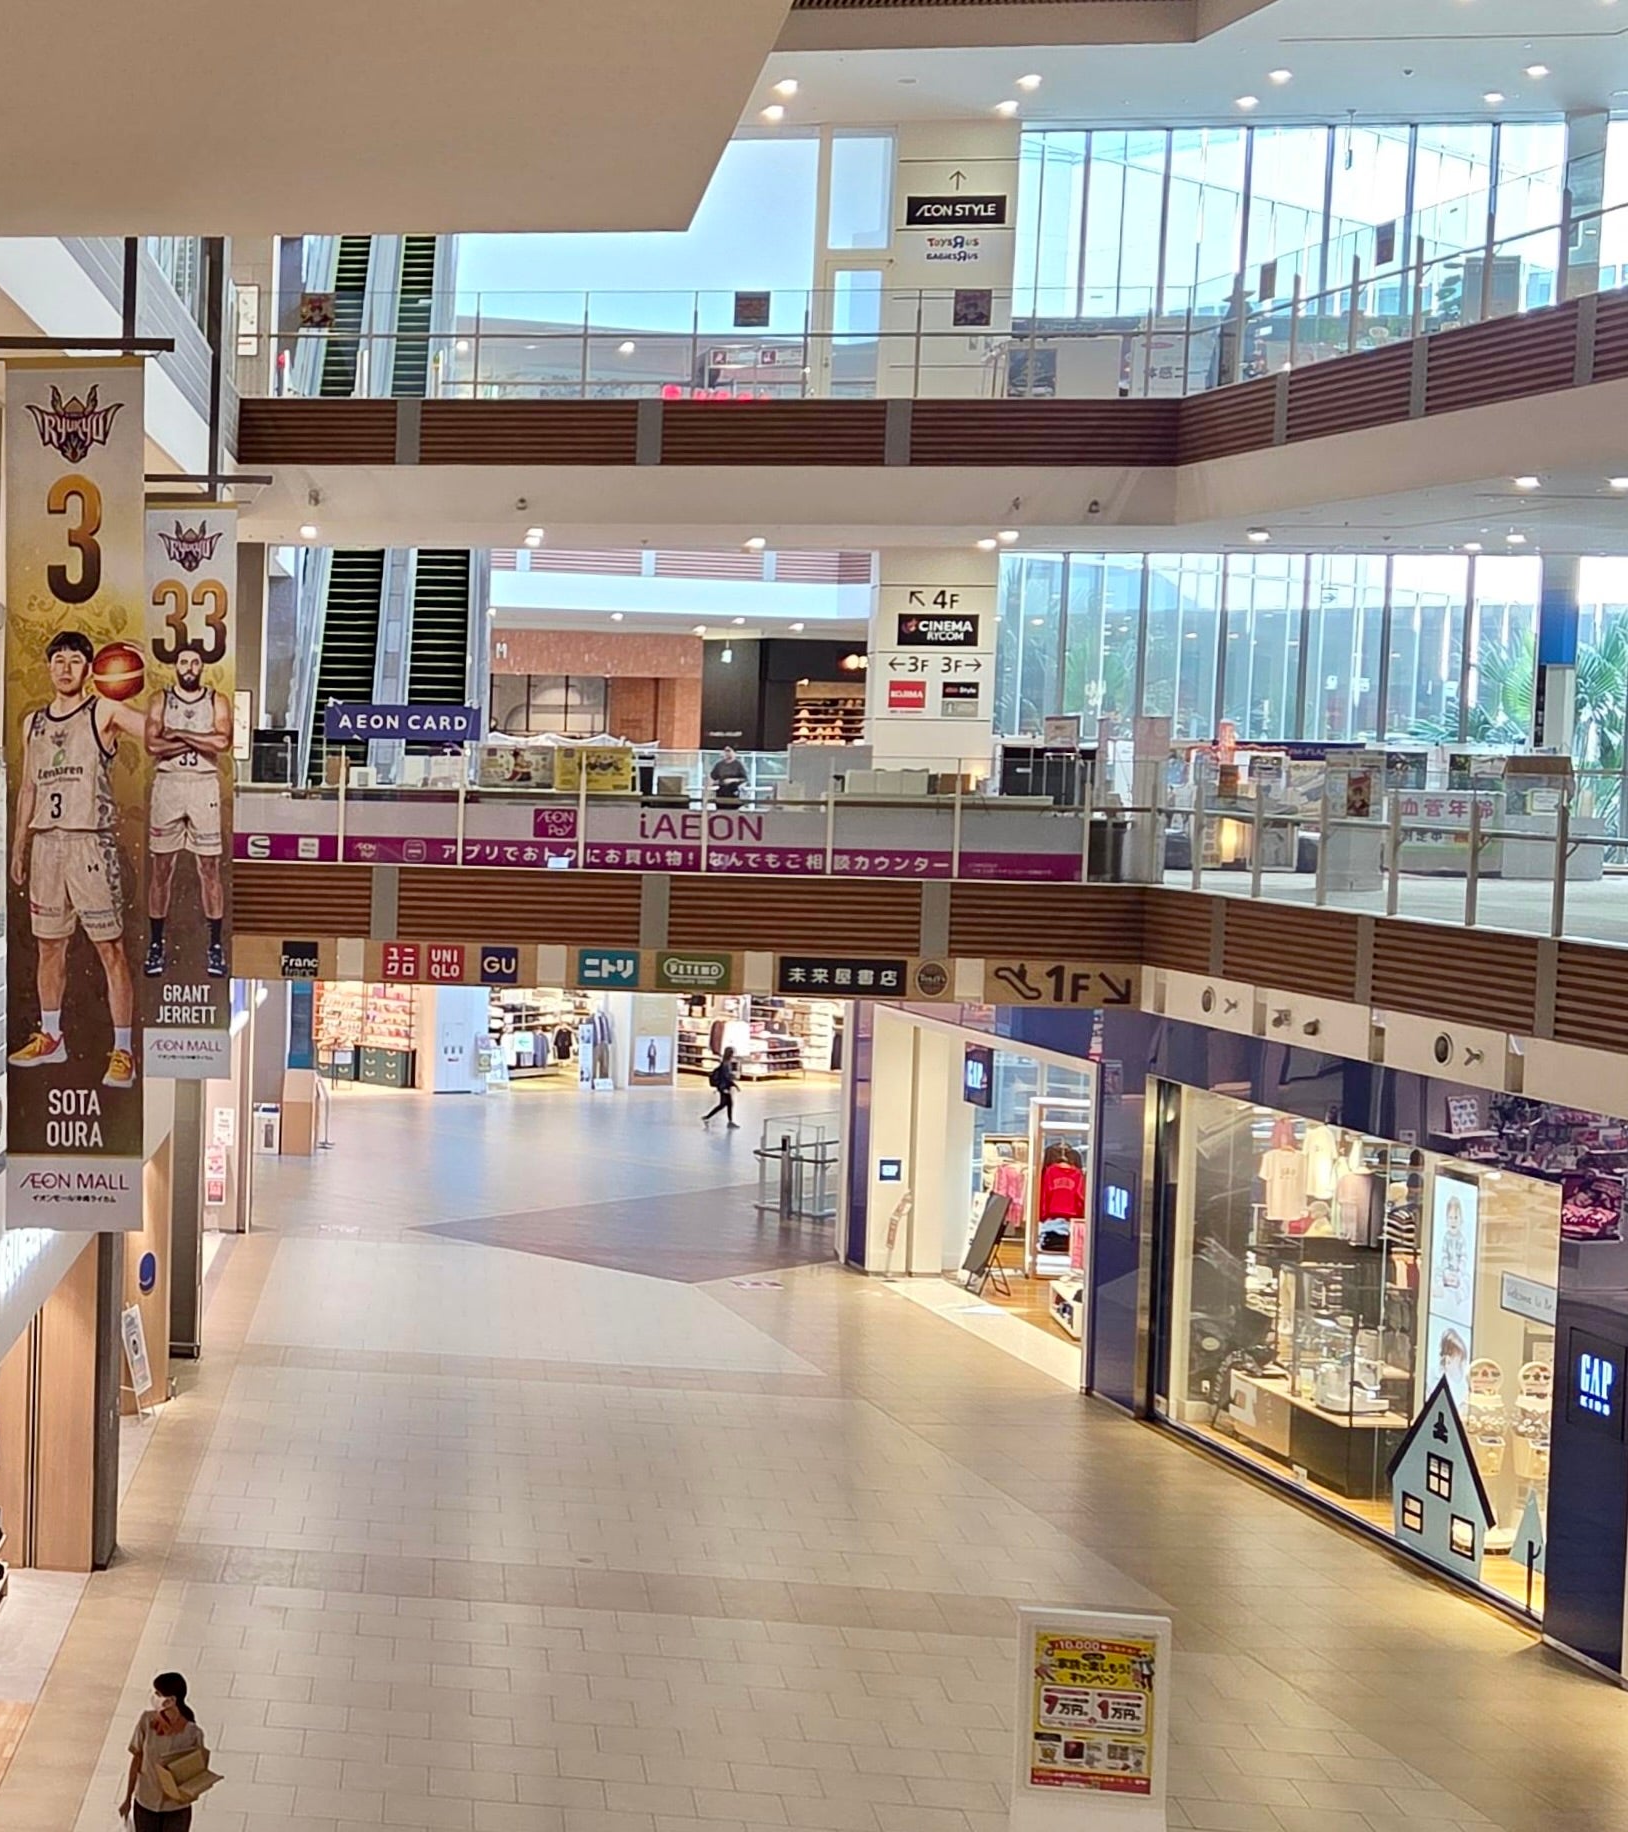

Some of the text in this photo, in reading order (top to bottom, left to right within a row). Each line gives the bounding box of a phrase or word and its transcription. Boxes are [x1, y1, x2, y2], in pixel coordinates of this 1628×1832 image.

[955, 203, 997, 217] STYLE
[44, 412, 105, 448] RYUKYU
[46, 473, 102, 604] 3
[932, 590, 960, 609] 4F
[151, 578, 229, 665] 33
[918, 620, 973, 633] CINEMA
[908, 656, 929, 673] 3F
[940, 656, 963, 673] 3F
[338, 714, 468, 731] AEON CARD
[179, 751, 198, 766] 33
[50, 793, 63, 819] 3
[639, 812, 764, 842] iAEON
[281, 955, 319, 968] Franc
[431, 948, 458, 962] UNI
[483, 955, 516, 974] GU
[430, 962, 460, 978] QLO
[583, 958, 634, 978] ニトリ
[788, 967, 898, 987] 未来屋書店
[1045, 964, 1091, 1001] 1F
[163, 984, 211, 1003] GRANT
[155, 1005, 217, 1024] JERRETT
[187, 1040, 222, 1052] MALL
[48, 1088, 101, 1116] SOTA
[46, 1120, 104, 1148] OURA
[76, 1173, 130, 1191] MALL
[1580, 1353, 1614, 1400] GAP
[1579, 1394, 1611, 1417] KIDS
